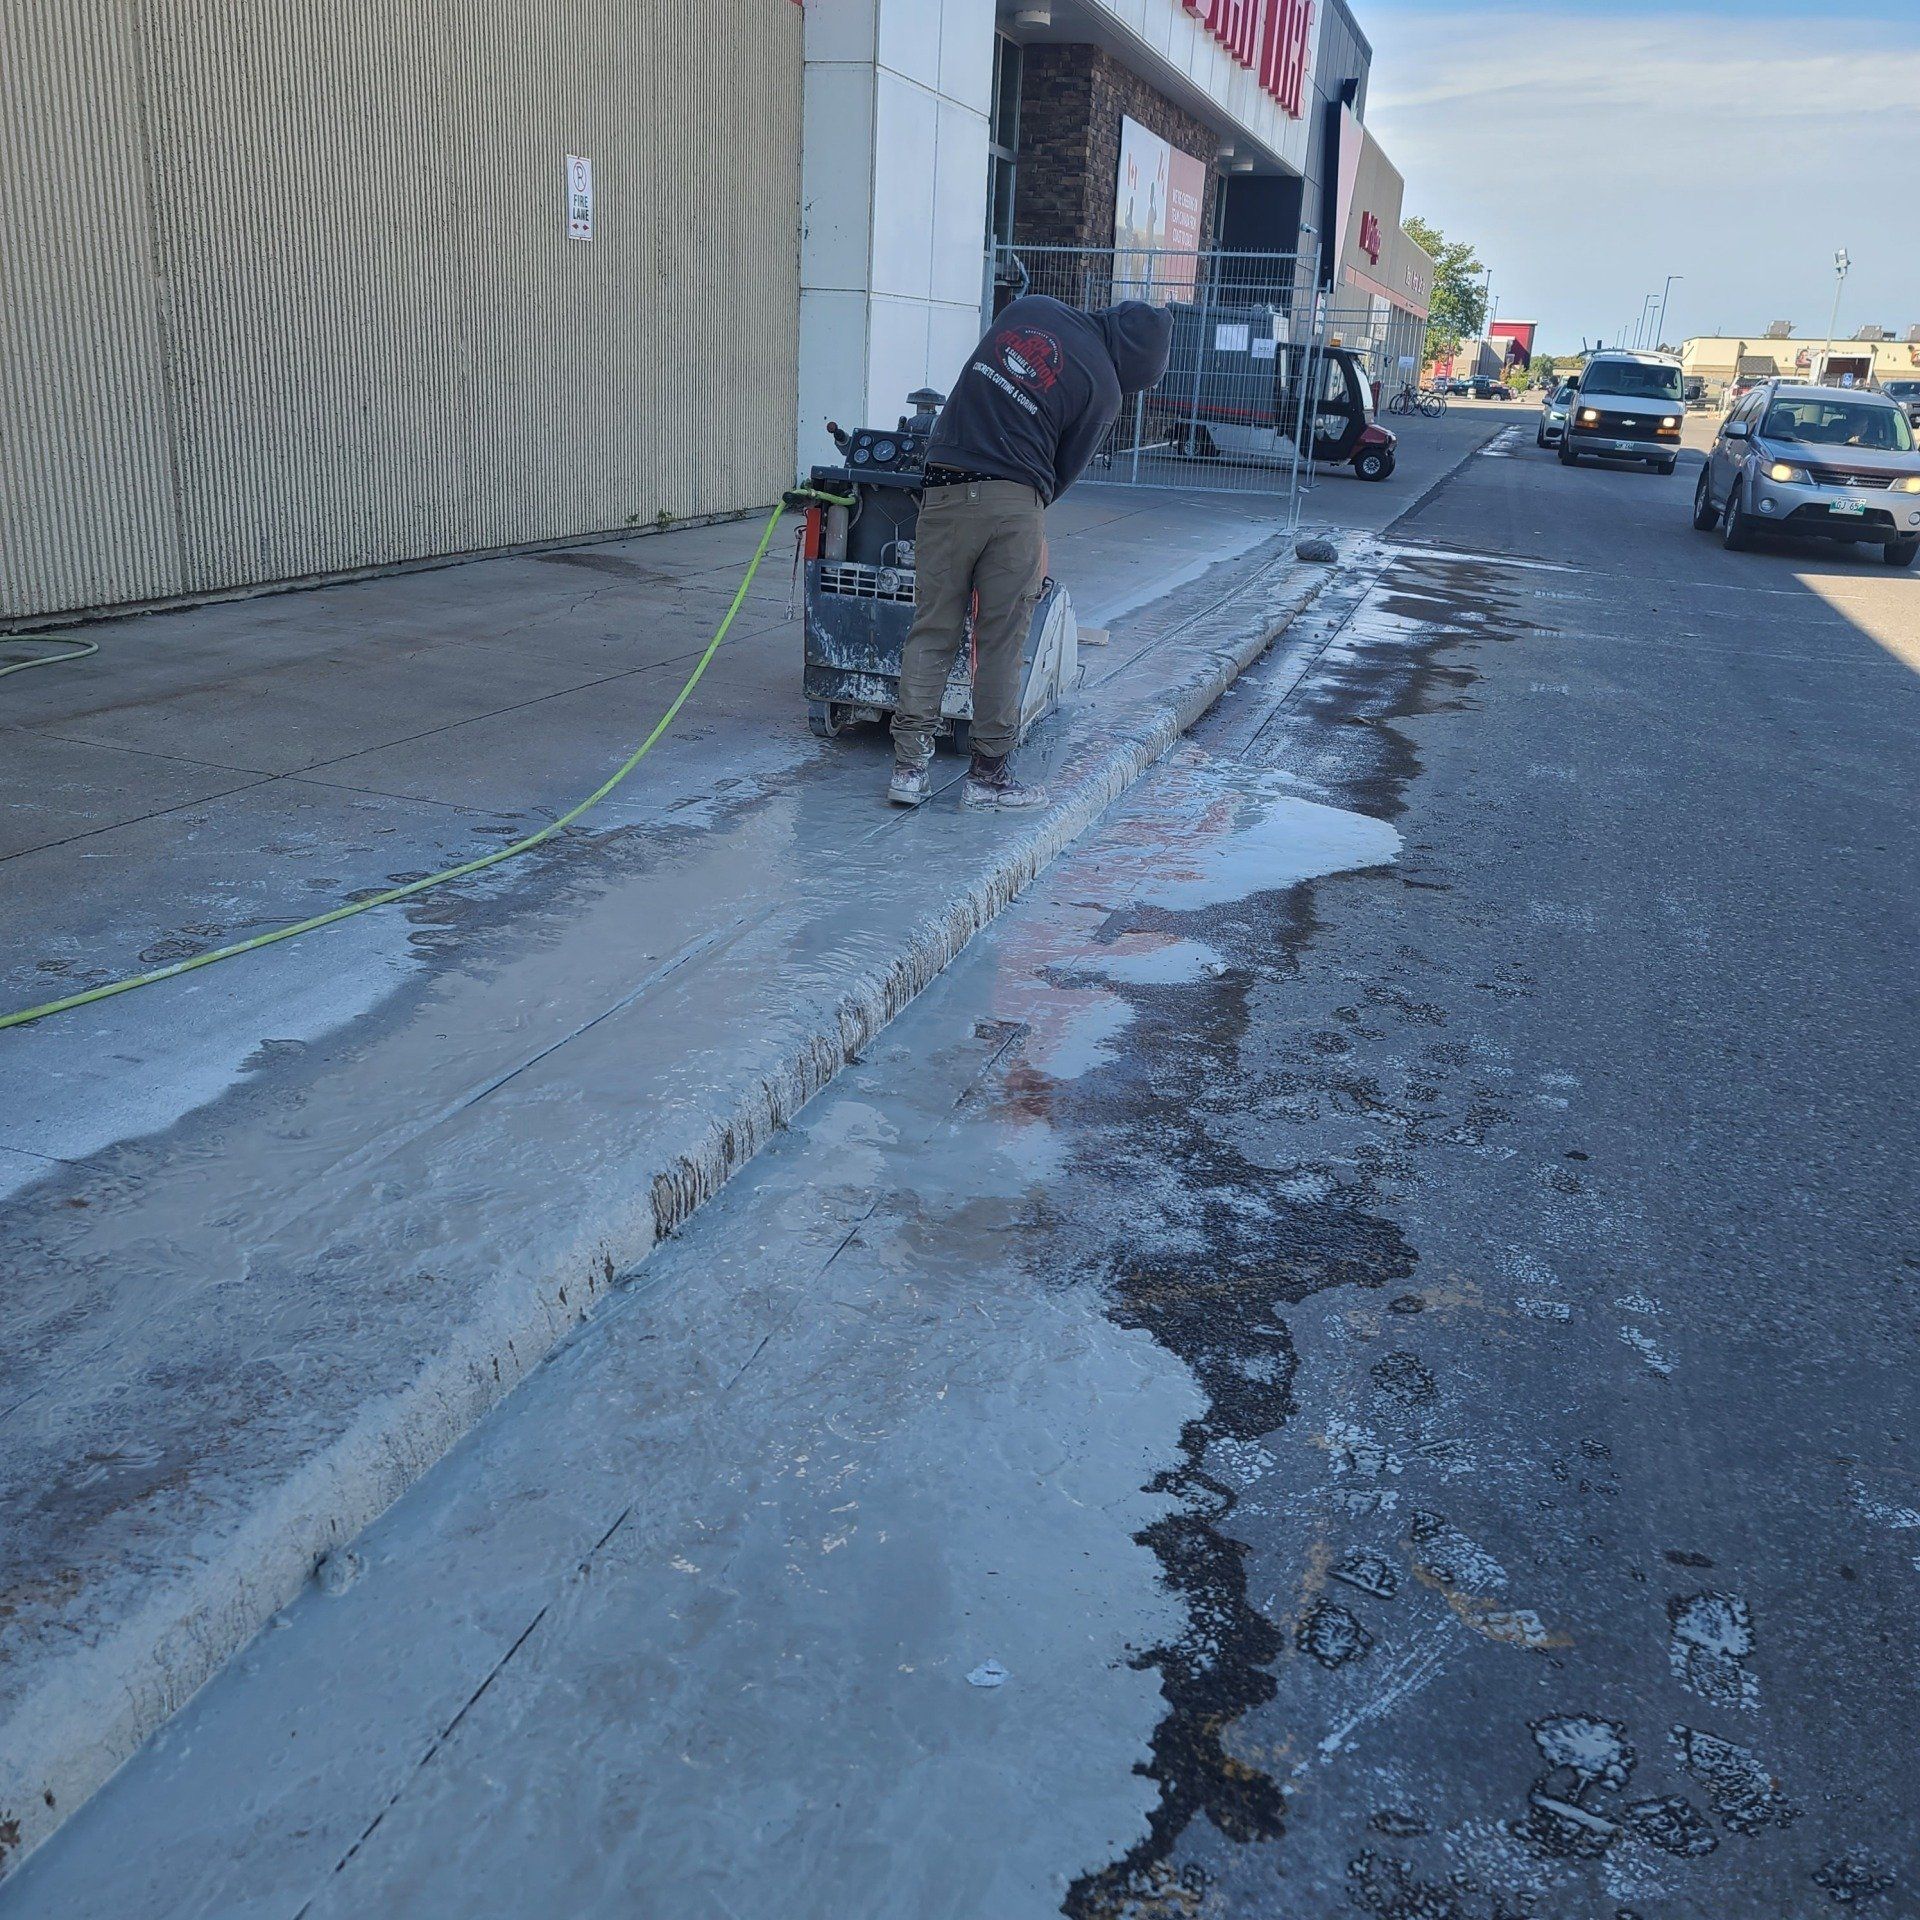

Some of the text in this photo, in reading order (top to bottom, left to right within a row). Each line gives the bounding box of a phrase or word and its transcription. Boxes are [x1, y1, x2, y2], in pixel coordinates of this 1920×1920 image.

[573, 194, 588, 208] FIRE
[573, 208, 589, 221] LANE
[996, 331, 1056, 388] DEMOLITION
[1008, 349, 1029, 368] SALVAGE
[1025, 364, 1037, 378] LTD
[992, 373, 1015, 395] CUTTING
[1012, 389, 1019, 399] &
[1017, 393, 1038, 415] CORING
